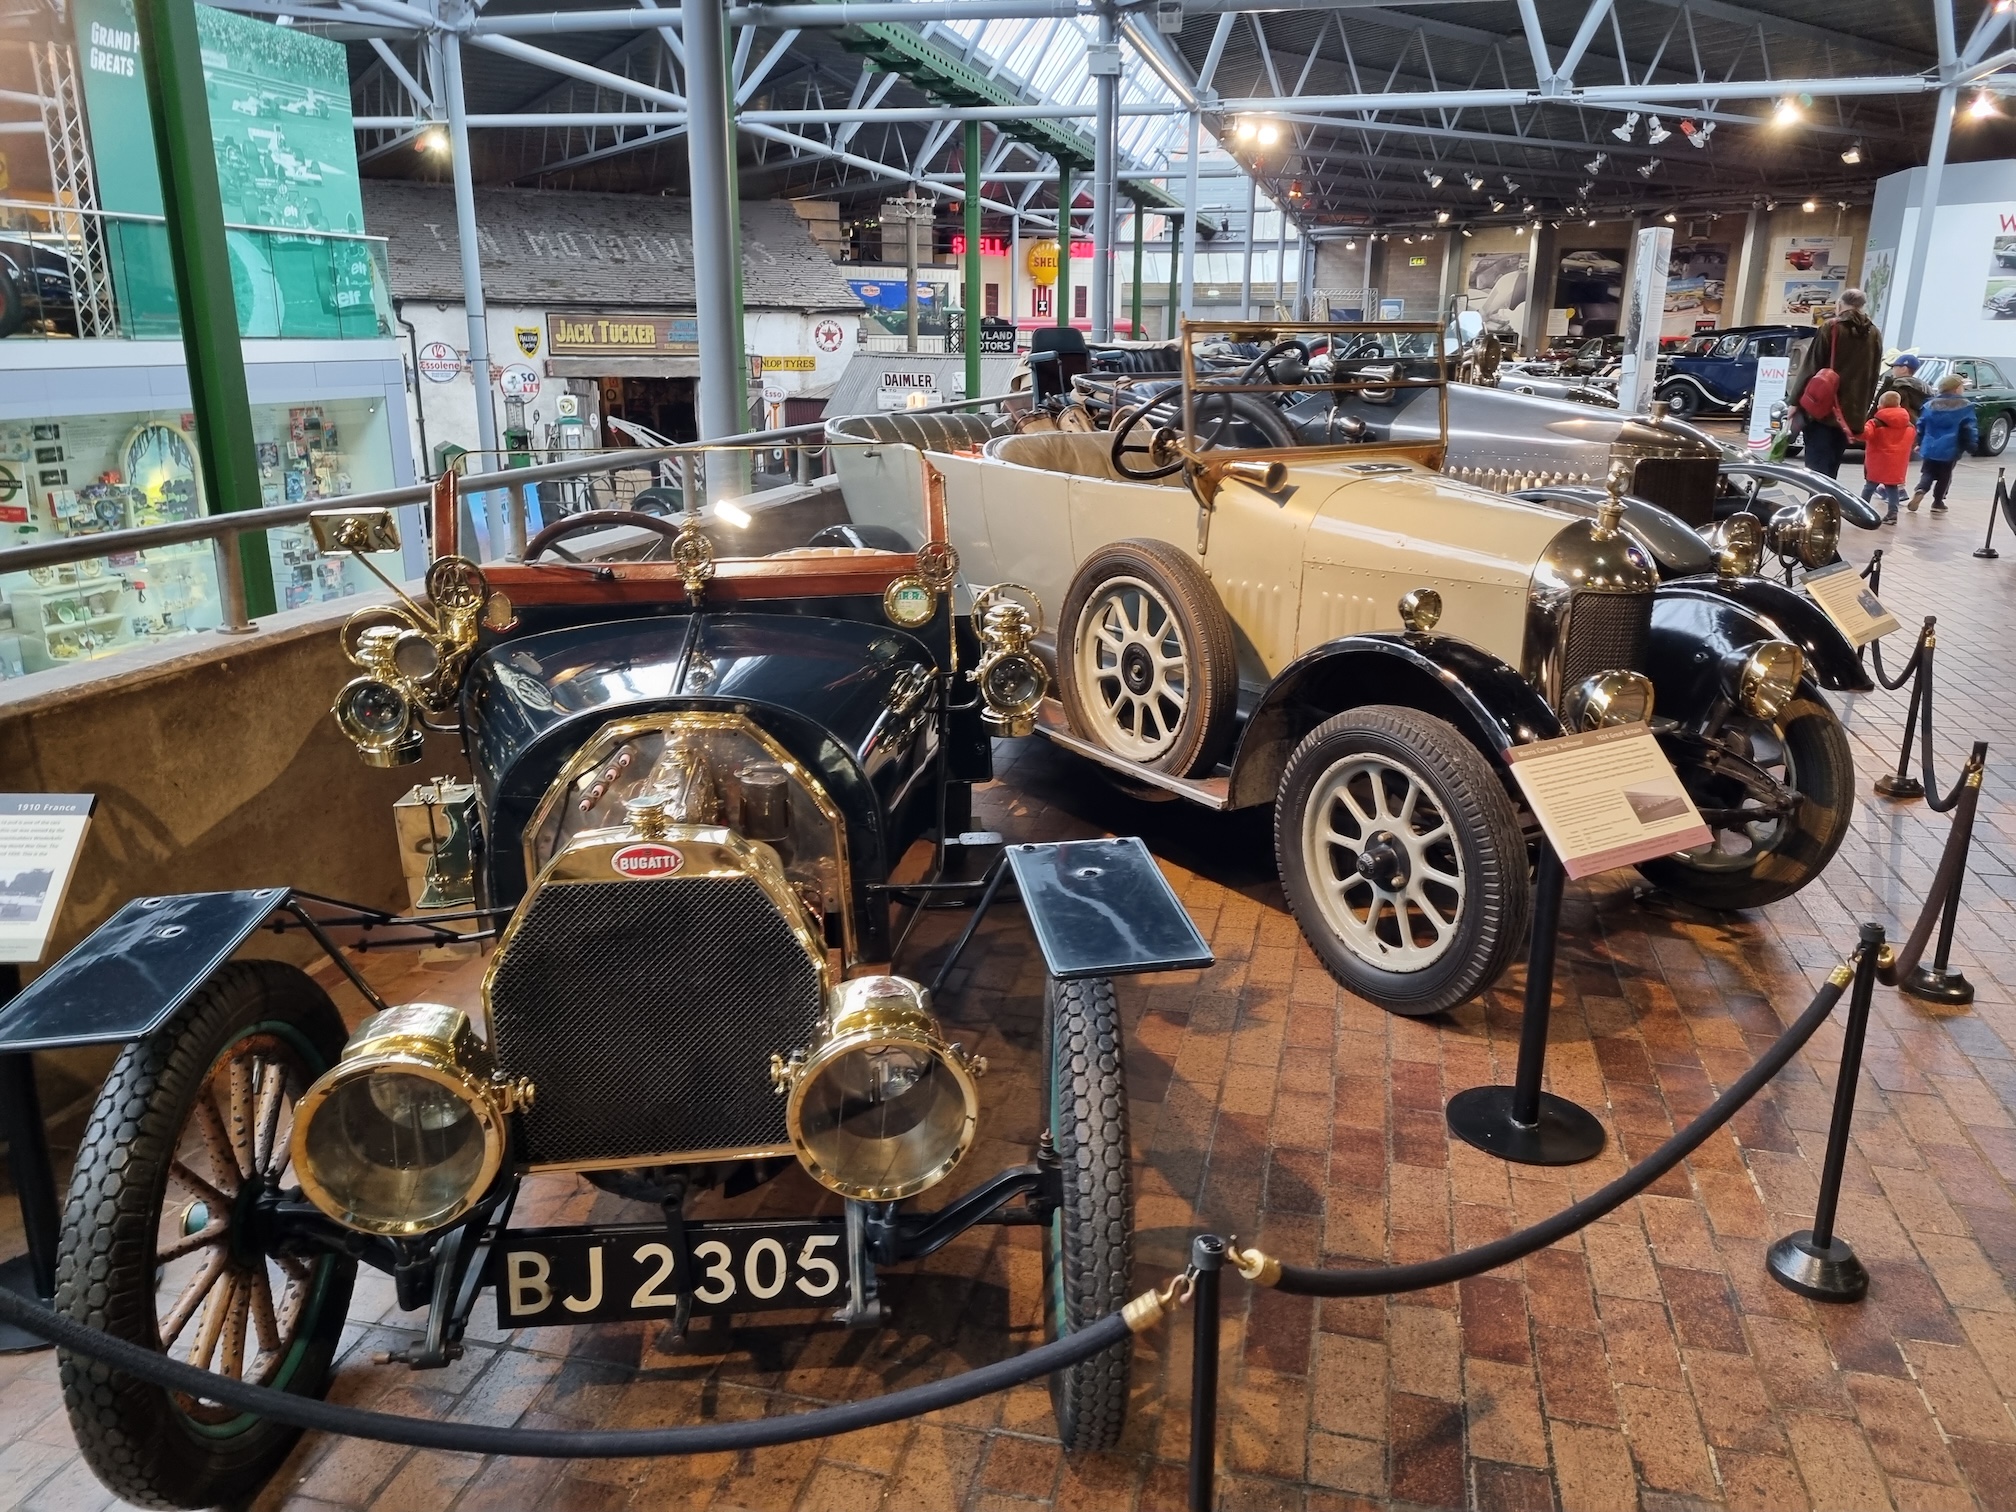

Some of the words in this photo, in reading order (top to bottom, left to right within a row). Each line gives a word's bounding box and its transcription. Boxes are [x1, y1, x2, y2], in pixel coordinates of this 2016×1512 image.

[91, 21, 131, 52] GRAND
[90, 46, 134, 77] GREATS
[351, 261, 367, 276] elf
[337, 290, 361, 308] elf
[556, 320, 595, 342] JACK
[598, 321, 655, 343] TUCKER
[420, 361, 460, 370] Essolene
[761, 360, 781, 368] NLOP
[785, 360, 815, 368] TYRES
[884, 373, 932, 387] DAIMLER
[1761, 368, 1785, 379] WIN
[764, 390, 782, 398] Esso
[1517, 749, 1537, 758] Morris
[1537, 745, 1559, 754] Cowley
[1609, 731, 1625, 739] Great
[1624, 727, 1644, 736] Britain
[43, 803, 77, 811] France
[620, 855, 676, 871] BUGATTI
[507, 1245, 604, 1316] BJ
[630, 1234, 841, 1309] 2305
